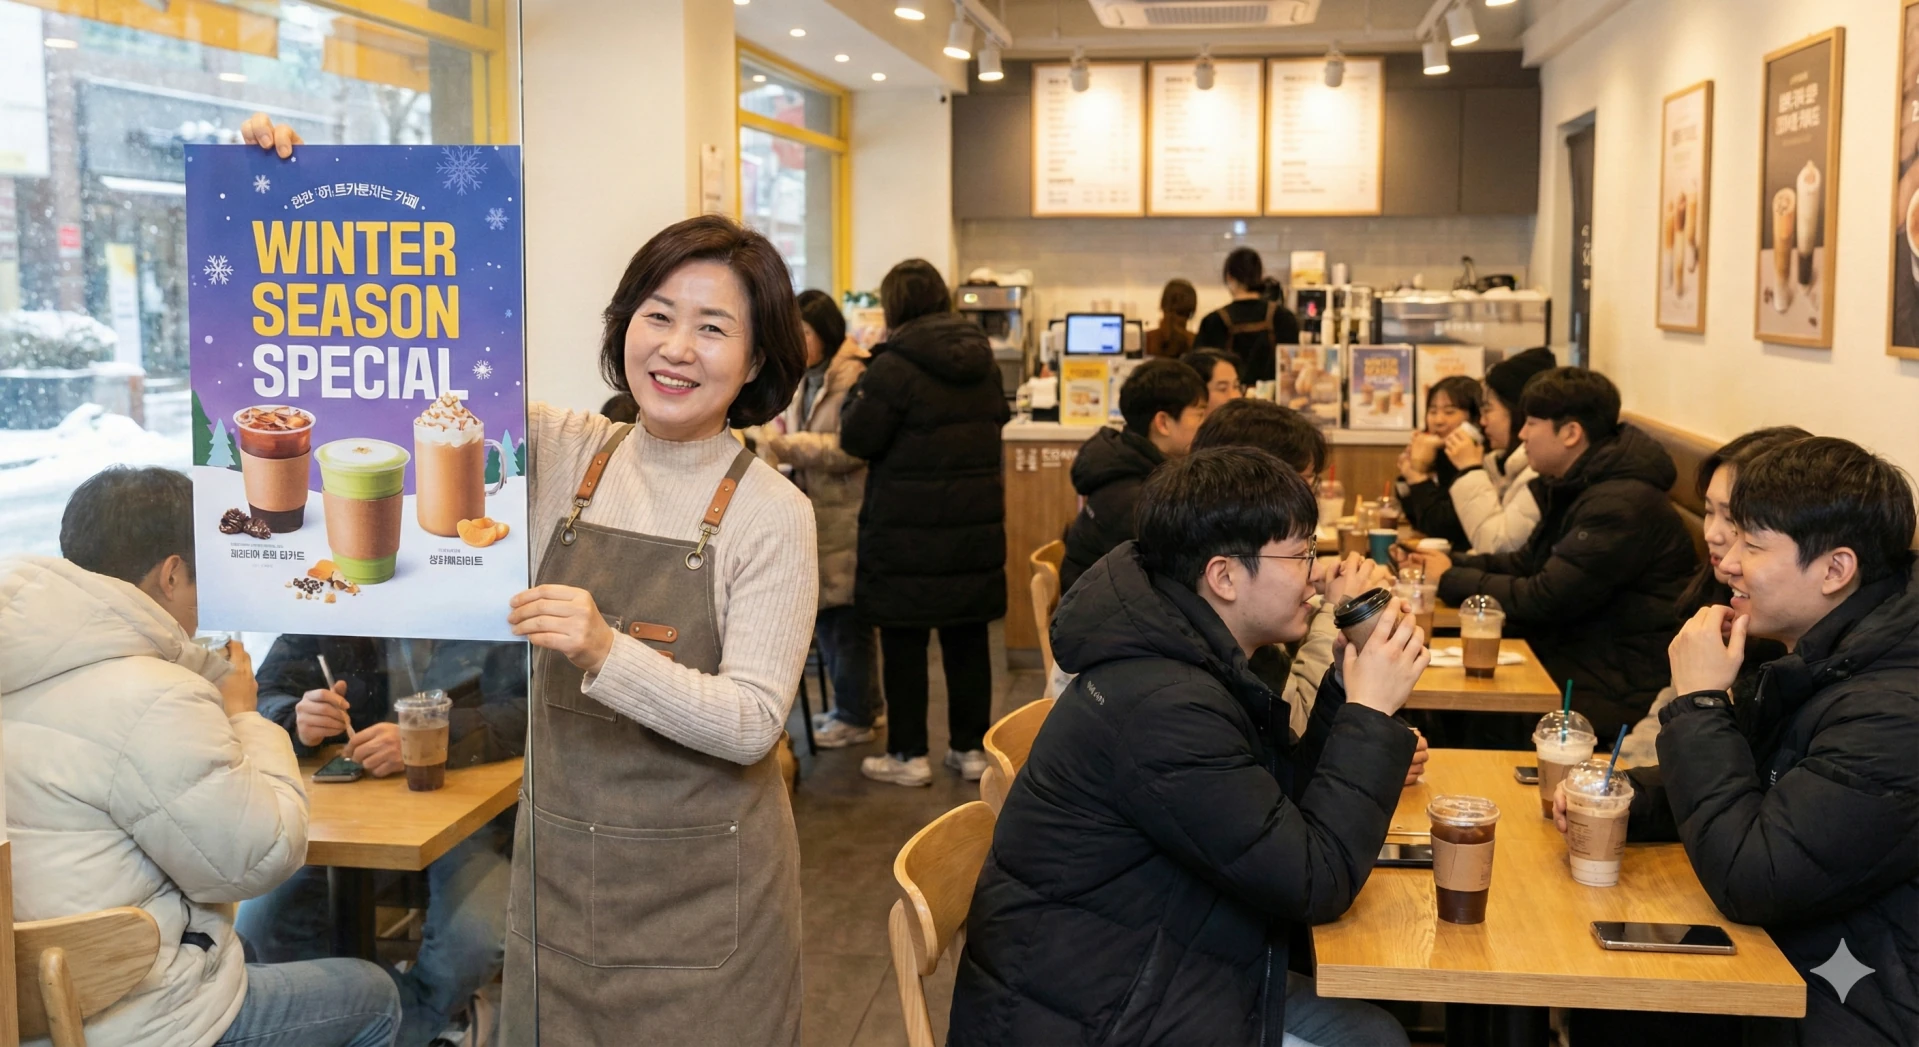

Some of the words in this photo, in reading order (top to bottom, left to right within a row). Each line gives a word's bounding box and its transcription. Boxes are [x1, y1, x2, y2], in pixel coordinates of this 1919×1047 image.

[394, 189, 420, 210] 카페
[252, 220, 457, 276] WINTER
[252, 281, 460, 339] SEASON
[253, 343, 469, 401] SPECIAL
